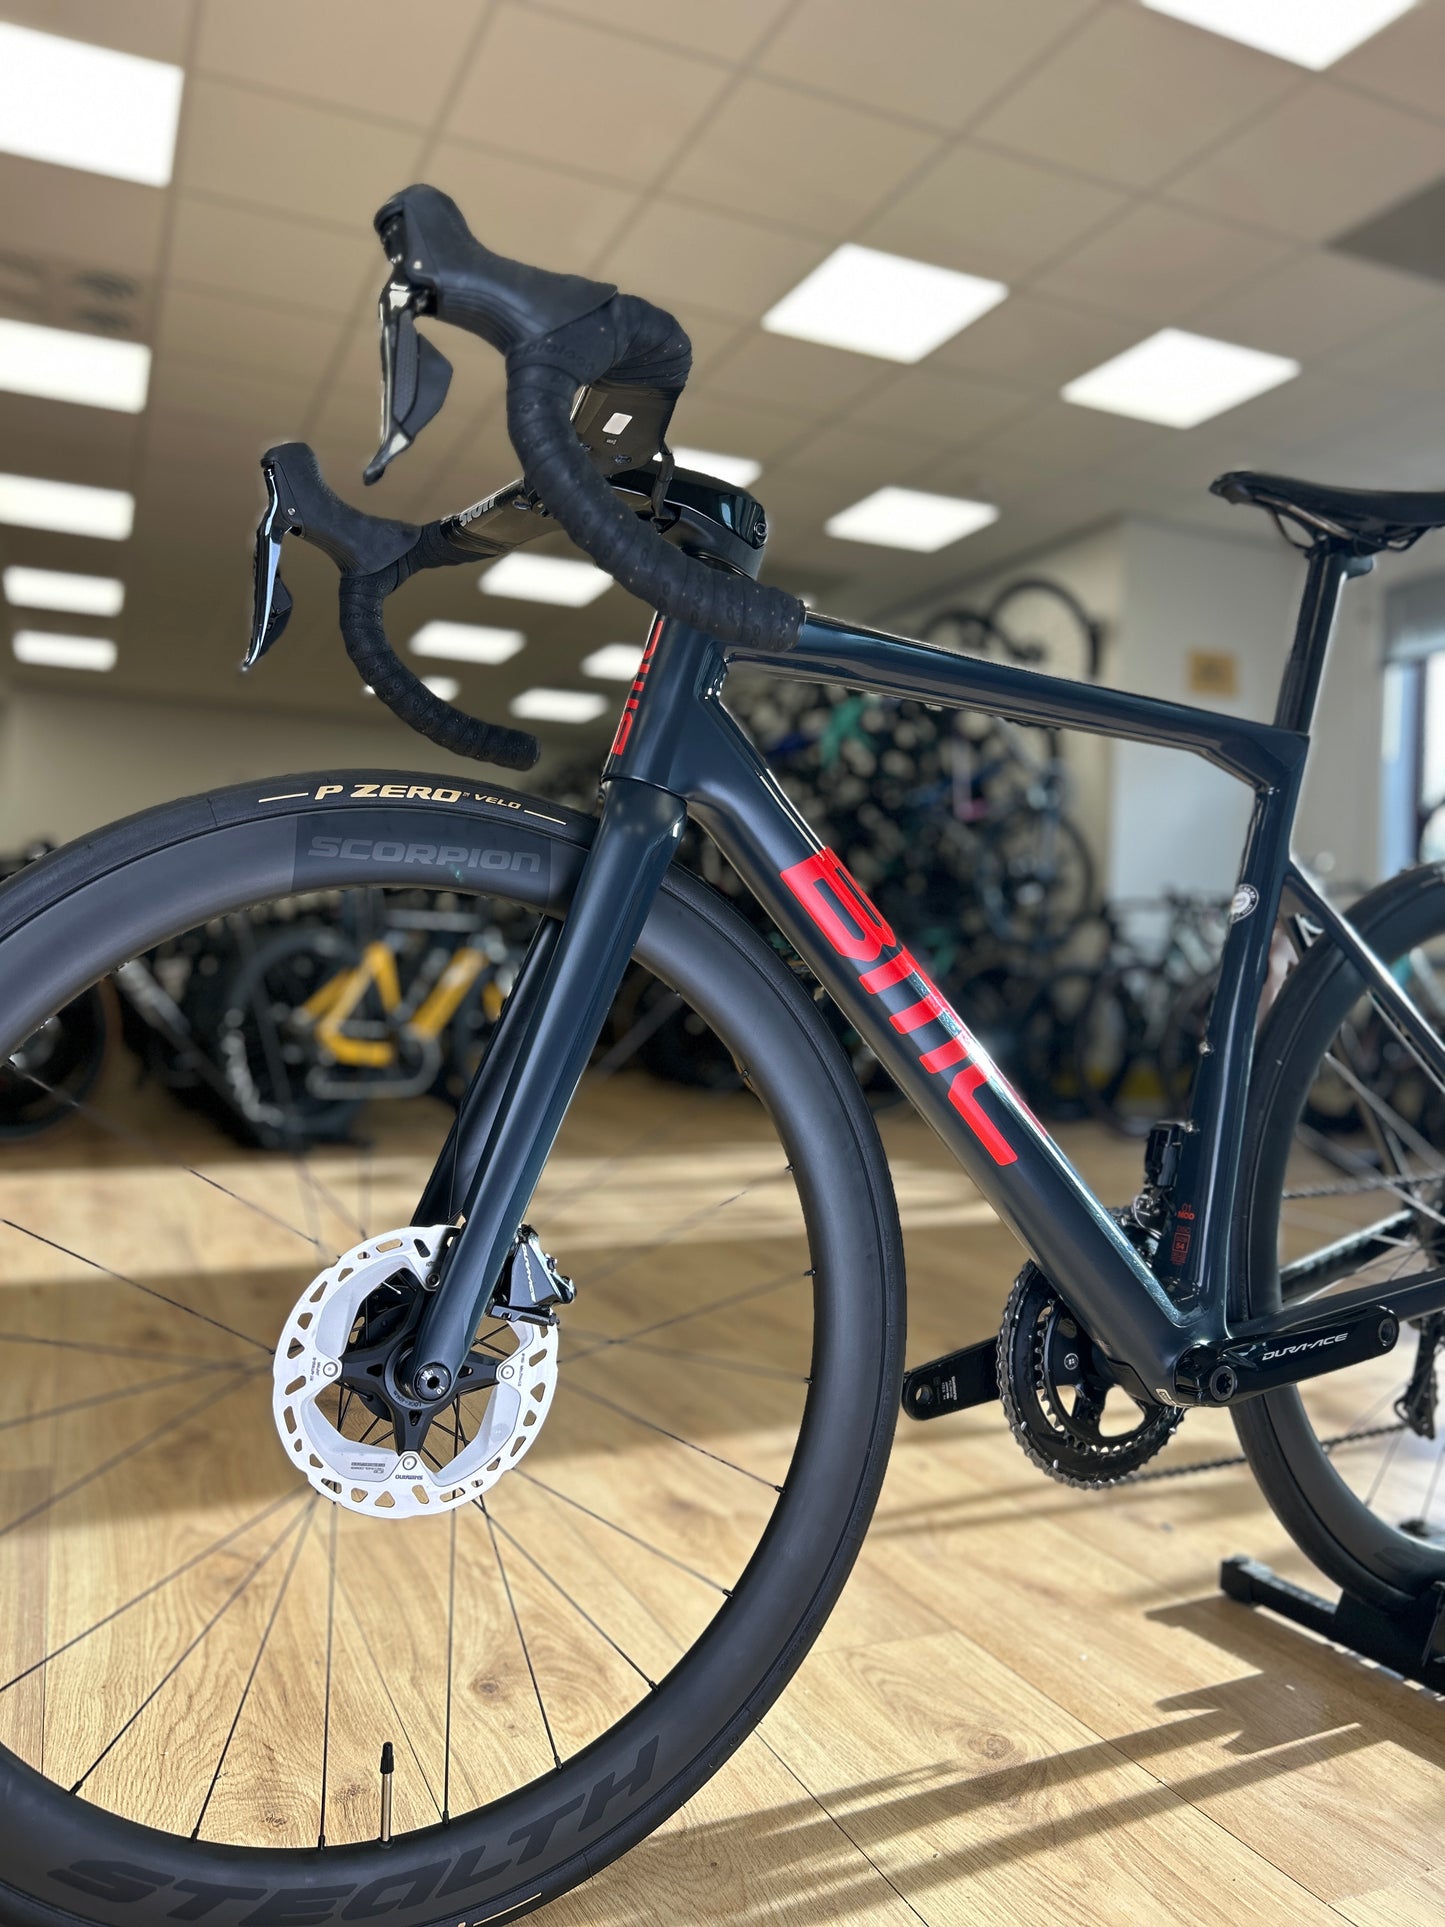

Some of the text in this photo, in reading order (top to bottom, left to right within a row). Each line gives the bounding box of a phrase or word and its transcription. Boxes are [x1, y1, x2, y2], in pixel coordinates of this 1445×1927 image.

[314, 784, 522, 810] P ZERO VELO
[307, 835, 542, 873] SCORPION
[1177, 1210, 1196, 1220] MOD
[1261, 1332, 1349, 1361] DURA-ACE
[46, 1734, 660, 1927] STEALTH
